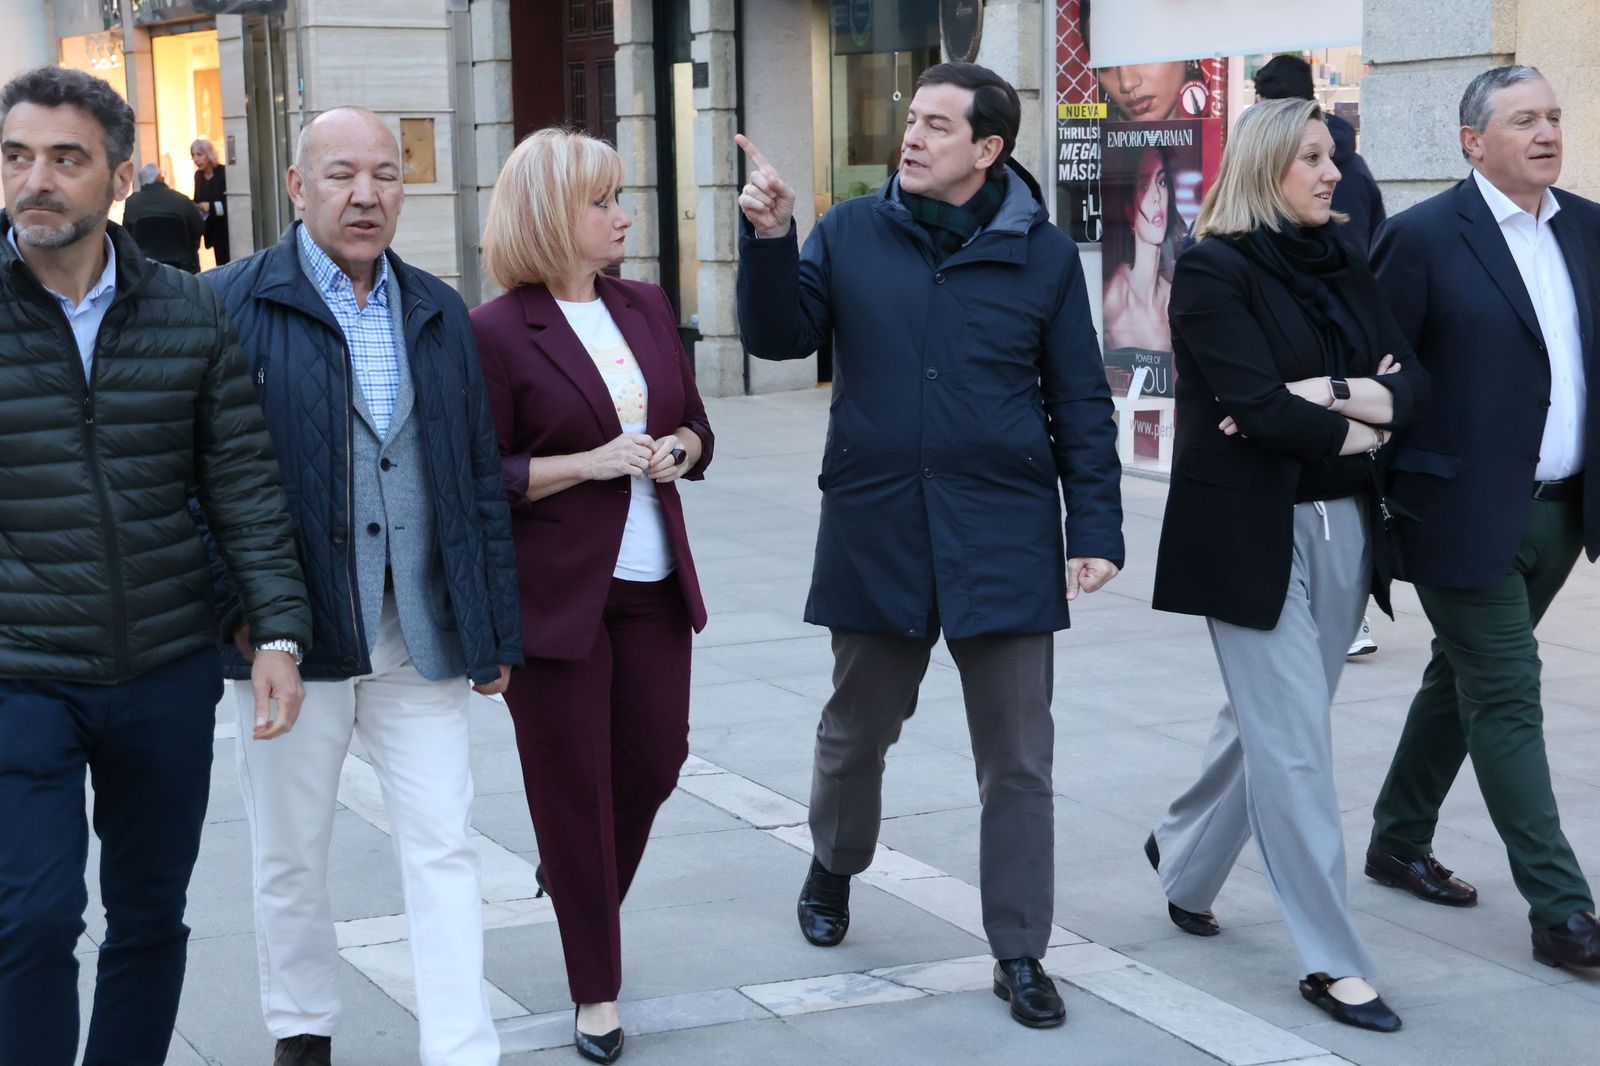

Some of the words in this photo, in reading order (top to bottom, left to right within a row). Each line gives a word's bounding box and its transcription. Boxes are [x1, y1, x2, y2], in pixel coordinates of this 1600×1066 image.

[1066, 105, 1099, 118] NUEVA
[1107, 130, 1146, 148] EMPORIO
[1156, 129, 1193, 146] ARMANI
[1135, 353, 1153, 363] POWER
[1153, 355, 1162, 364] OF
